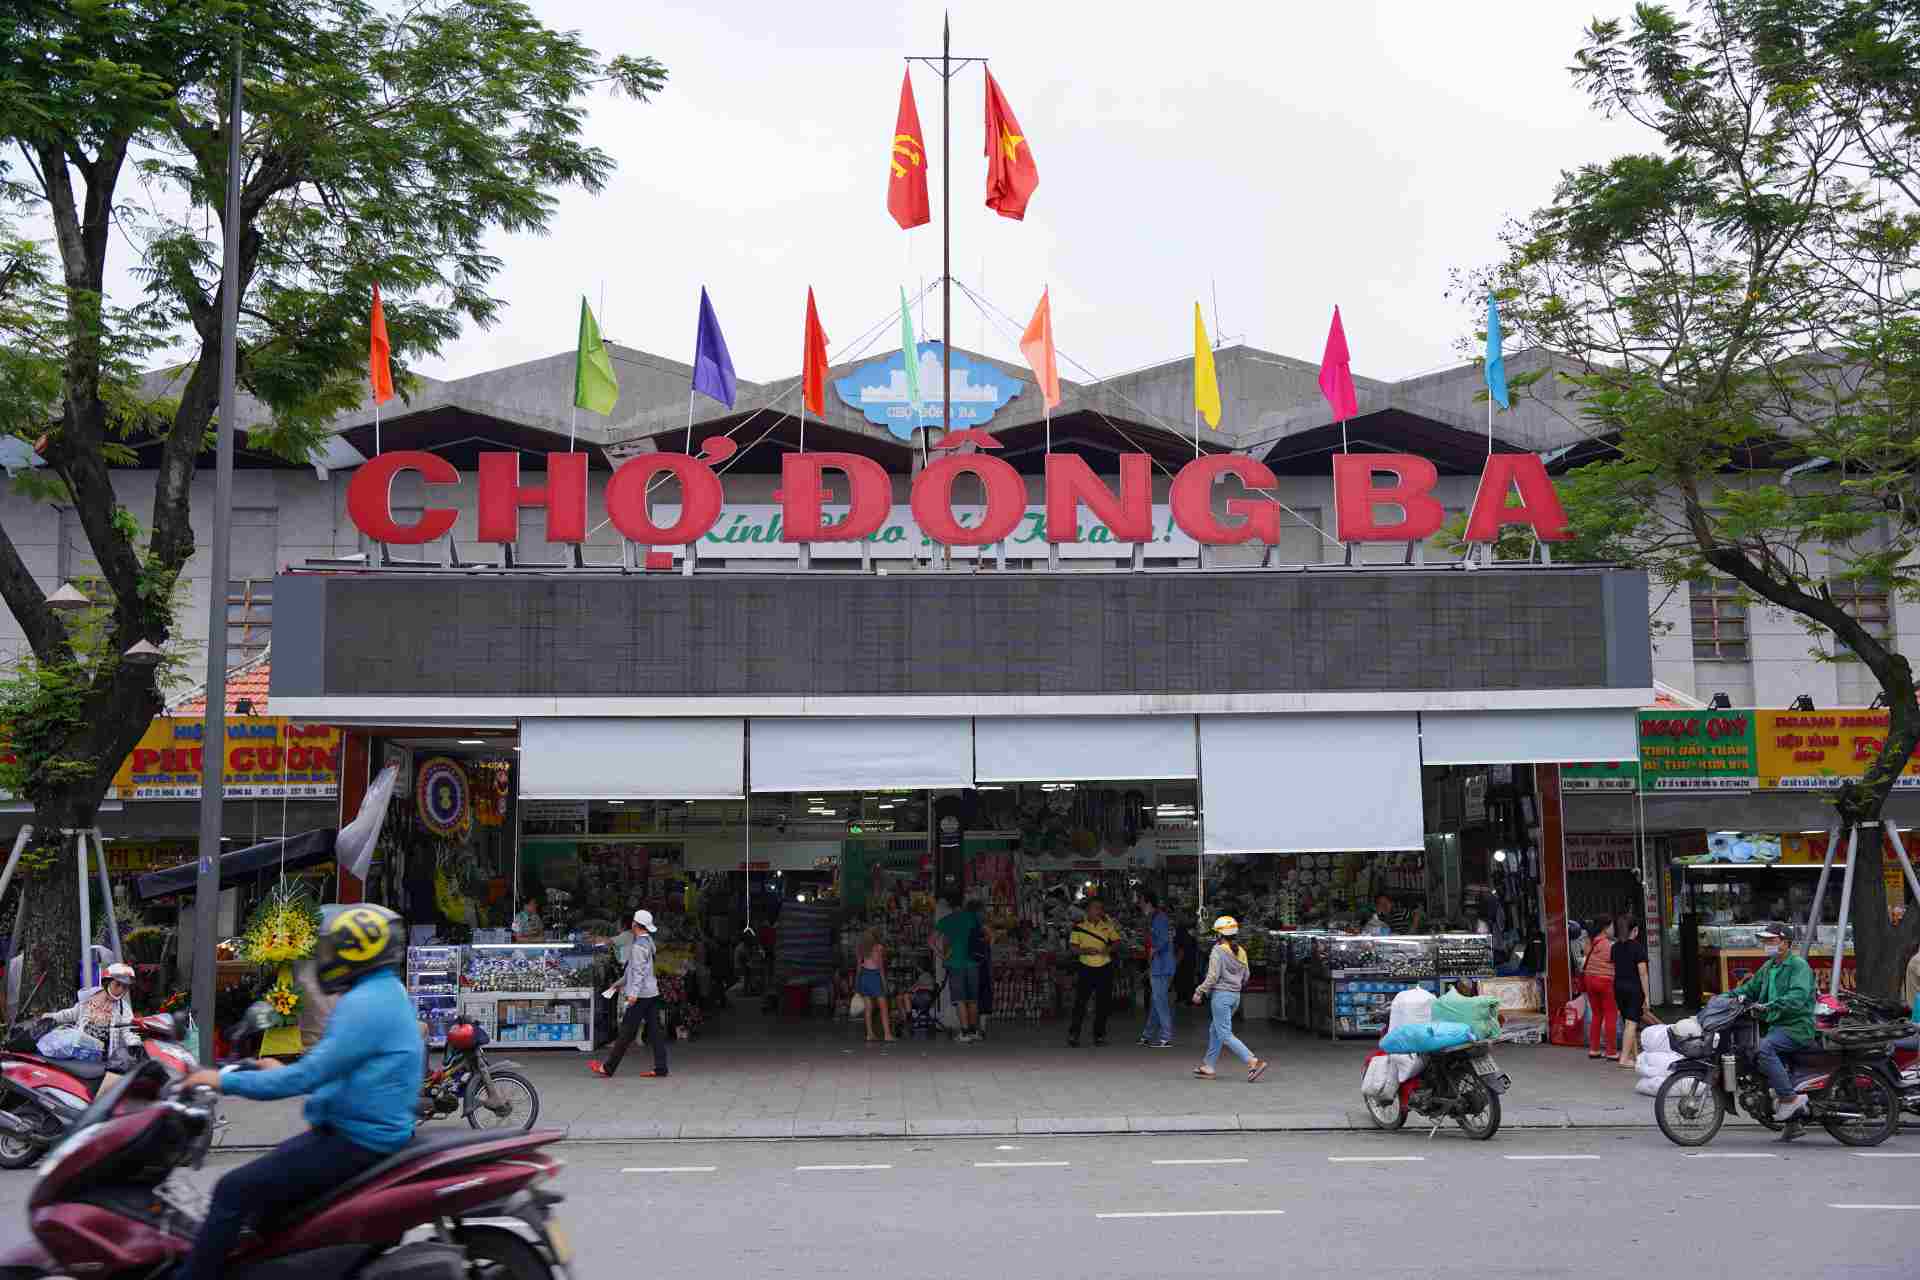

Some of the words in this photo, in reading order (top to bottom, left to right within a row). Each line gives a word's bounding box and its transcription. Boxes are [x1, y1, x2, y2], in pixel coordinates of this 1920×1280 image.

[918, 403, 953, 418] ĐÔN
[958, 406, 977, 418] BA
[346, 435, 736, 569] CHỢ
[772, 428, 1281, 546] ĐÔNG
[1334, 452, 1577, 542] BA
